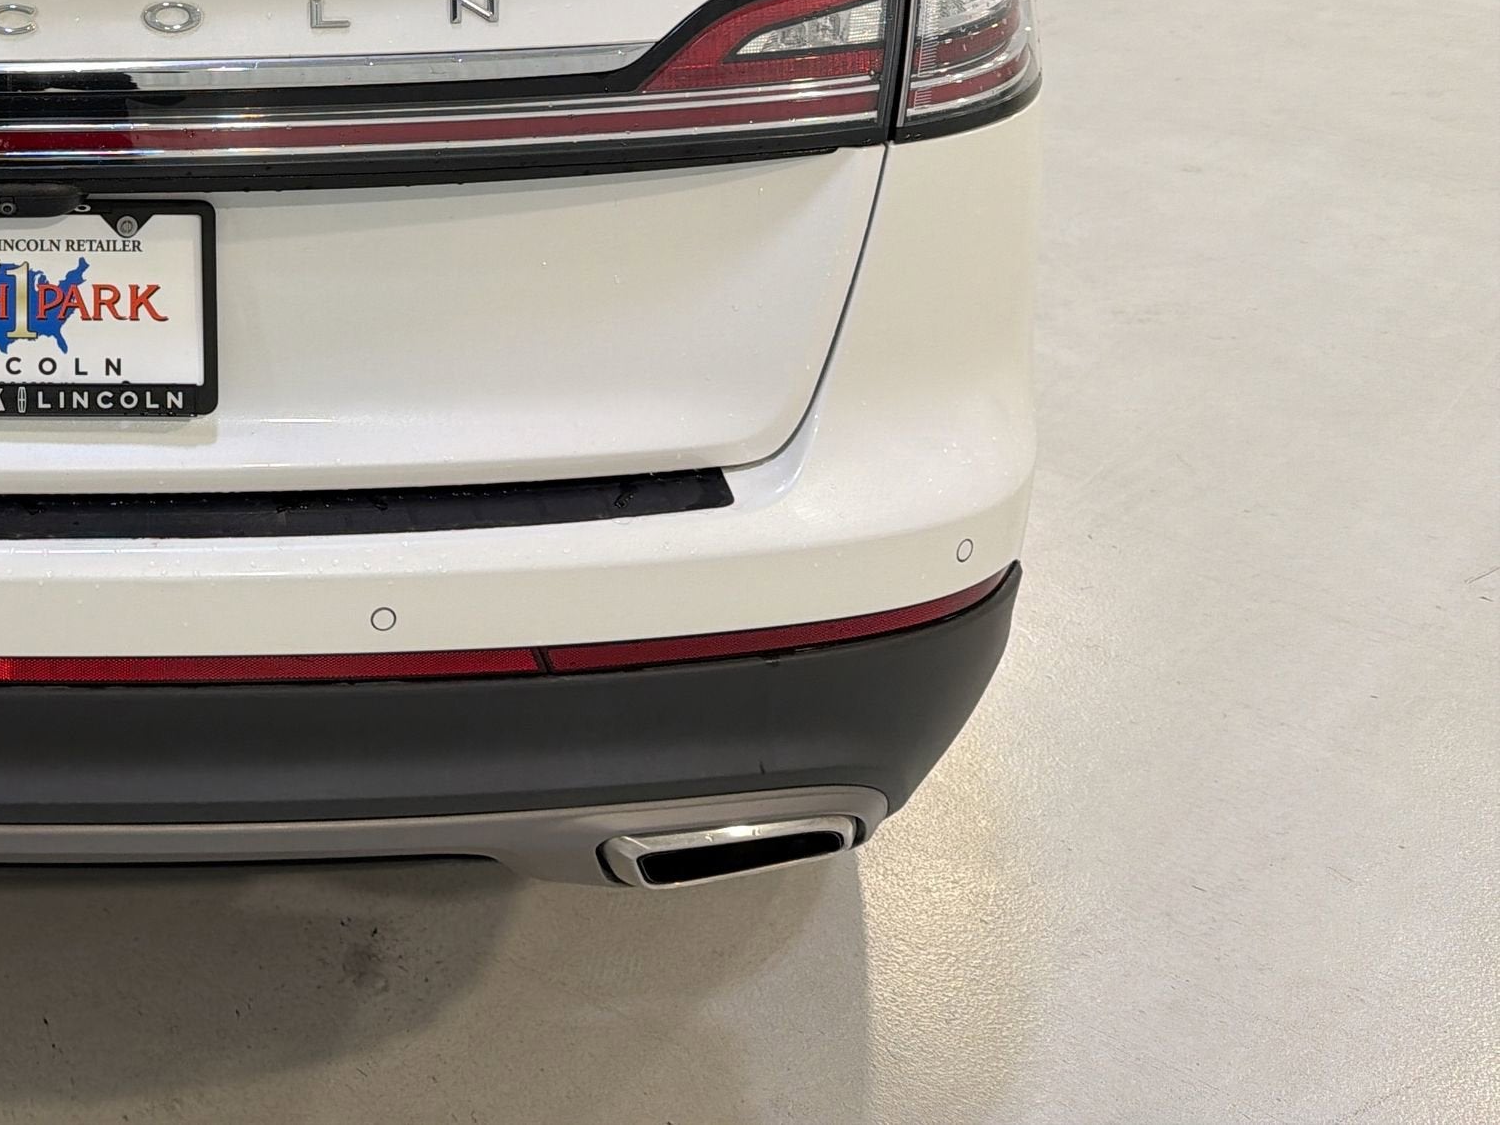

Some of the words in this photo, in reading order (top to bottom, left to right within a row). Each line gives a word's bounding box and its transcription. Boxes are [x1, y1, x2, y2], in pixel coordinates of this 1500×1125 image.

[65, 239, 143, 253] RETAILER
[36, 284, 169, 322] PARK
[37, 390, 184, 410] LINCOLN
